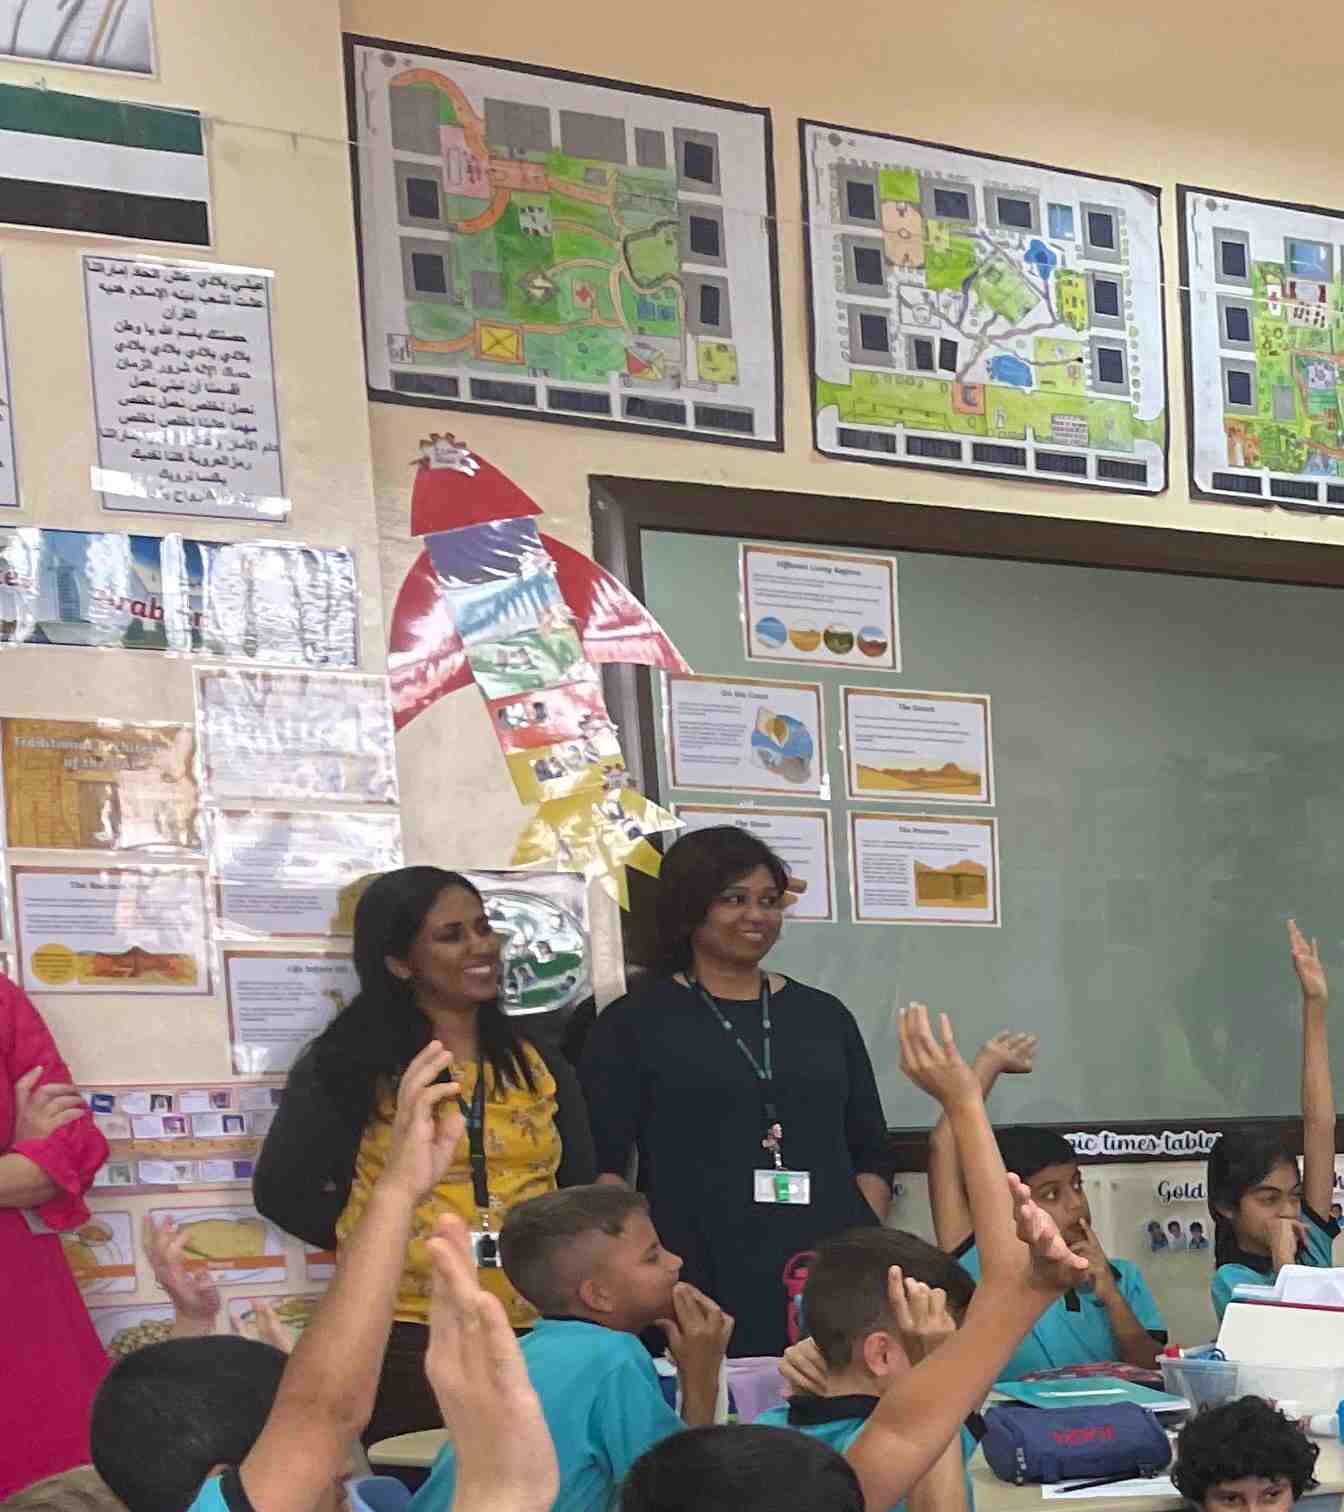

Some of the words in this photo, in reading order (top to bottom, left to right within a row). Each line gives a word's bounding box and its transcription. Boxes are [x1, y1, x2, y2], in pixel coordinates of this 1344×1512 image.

[1103, 1132, 1159, 1151] times
[1164, 1131, 1217, 1151] table
[1157, 1180, 1204, 1202] Gold
